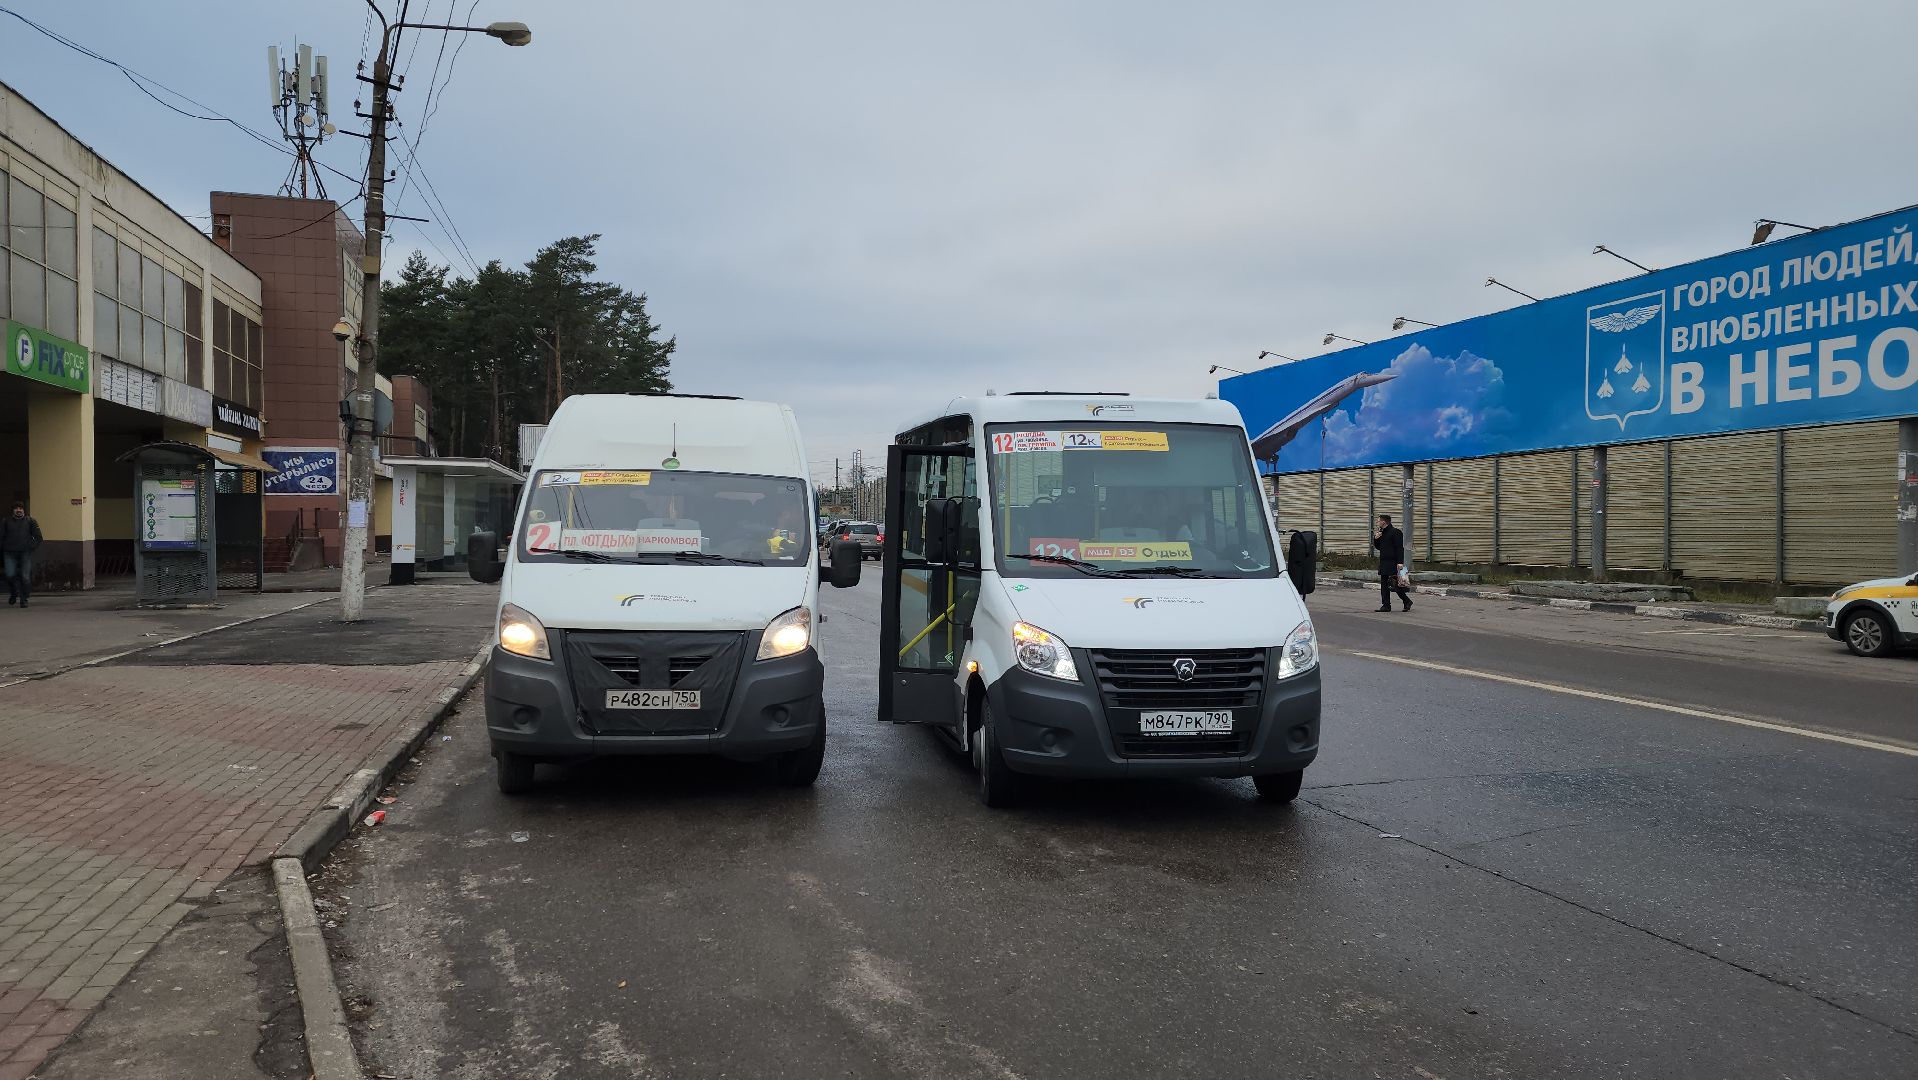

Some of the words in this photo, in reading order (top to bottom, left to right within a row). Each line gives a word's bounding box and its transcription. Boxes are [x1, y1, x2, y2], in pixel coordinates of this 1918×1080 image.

[1673, 265, 1771, 311] ГОРОД
[1672, 281, 1918, 352] ВЛЮБЛЕННЫХ
[1671, 362, 1705, 415] В
[1730, 327, 1918, 409] НЕБО
[994, 433, 1014, 452] 12
[308, 476, 325, 484] 24
[638, 536, 699, 546] НАРКОМВОД
[610, 692, 671, 707] Р482СН
[673, 691, 697, 704] 750
[1145, 714, 1203, 730] М847РК
[1206, 713, 1229, 725] 790
